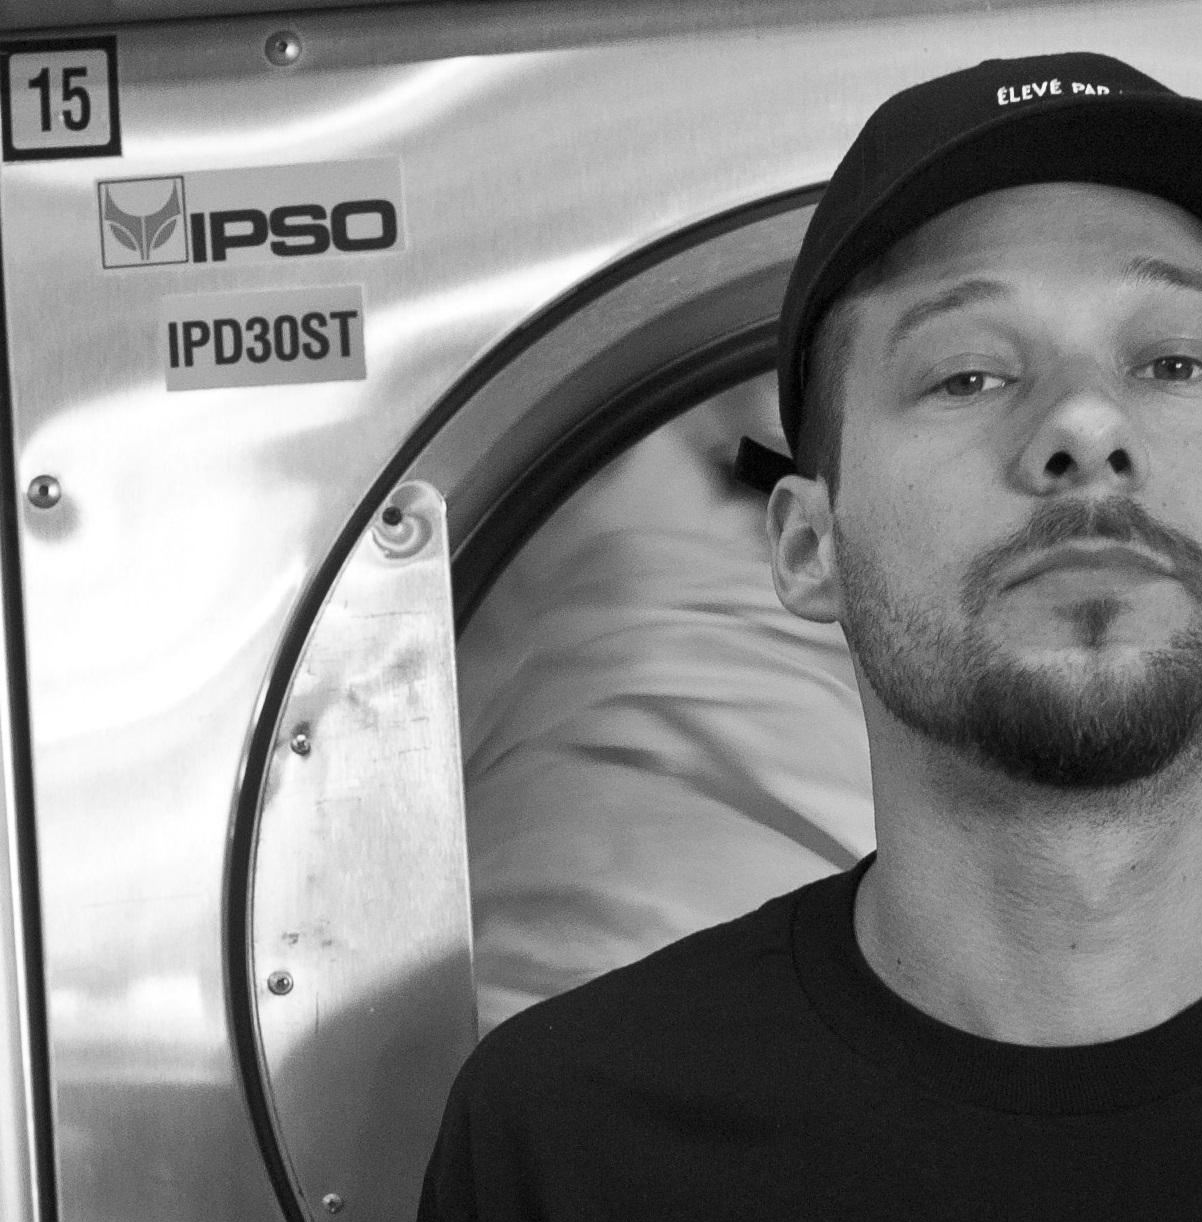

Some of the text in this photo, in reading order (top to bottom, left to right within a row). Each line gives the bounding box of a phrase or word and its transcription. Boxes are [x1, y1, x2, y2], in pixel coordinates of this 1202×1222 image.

[28, 66, 92, 133] 15
[996, 78, 1063, 106] ÉLEVÉ
[190, 199, 398, 264] IPSO
[167, 310, 359, 369] IPD30ST
